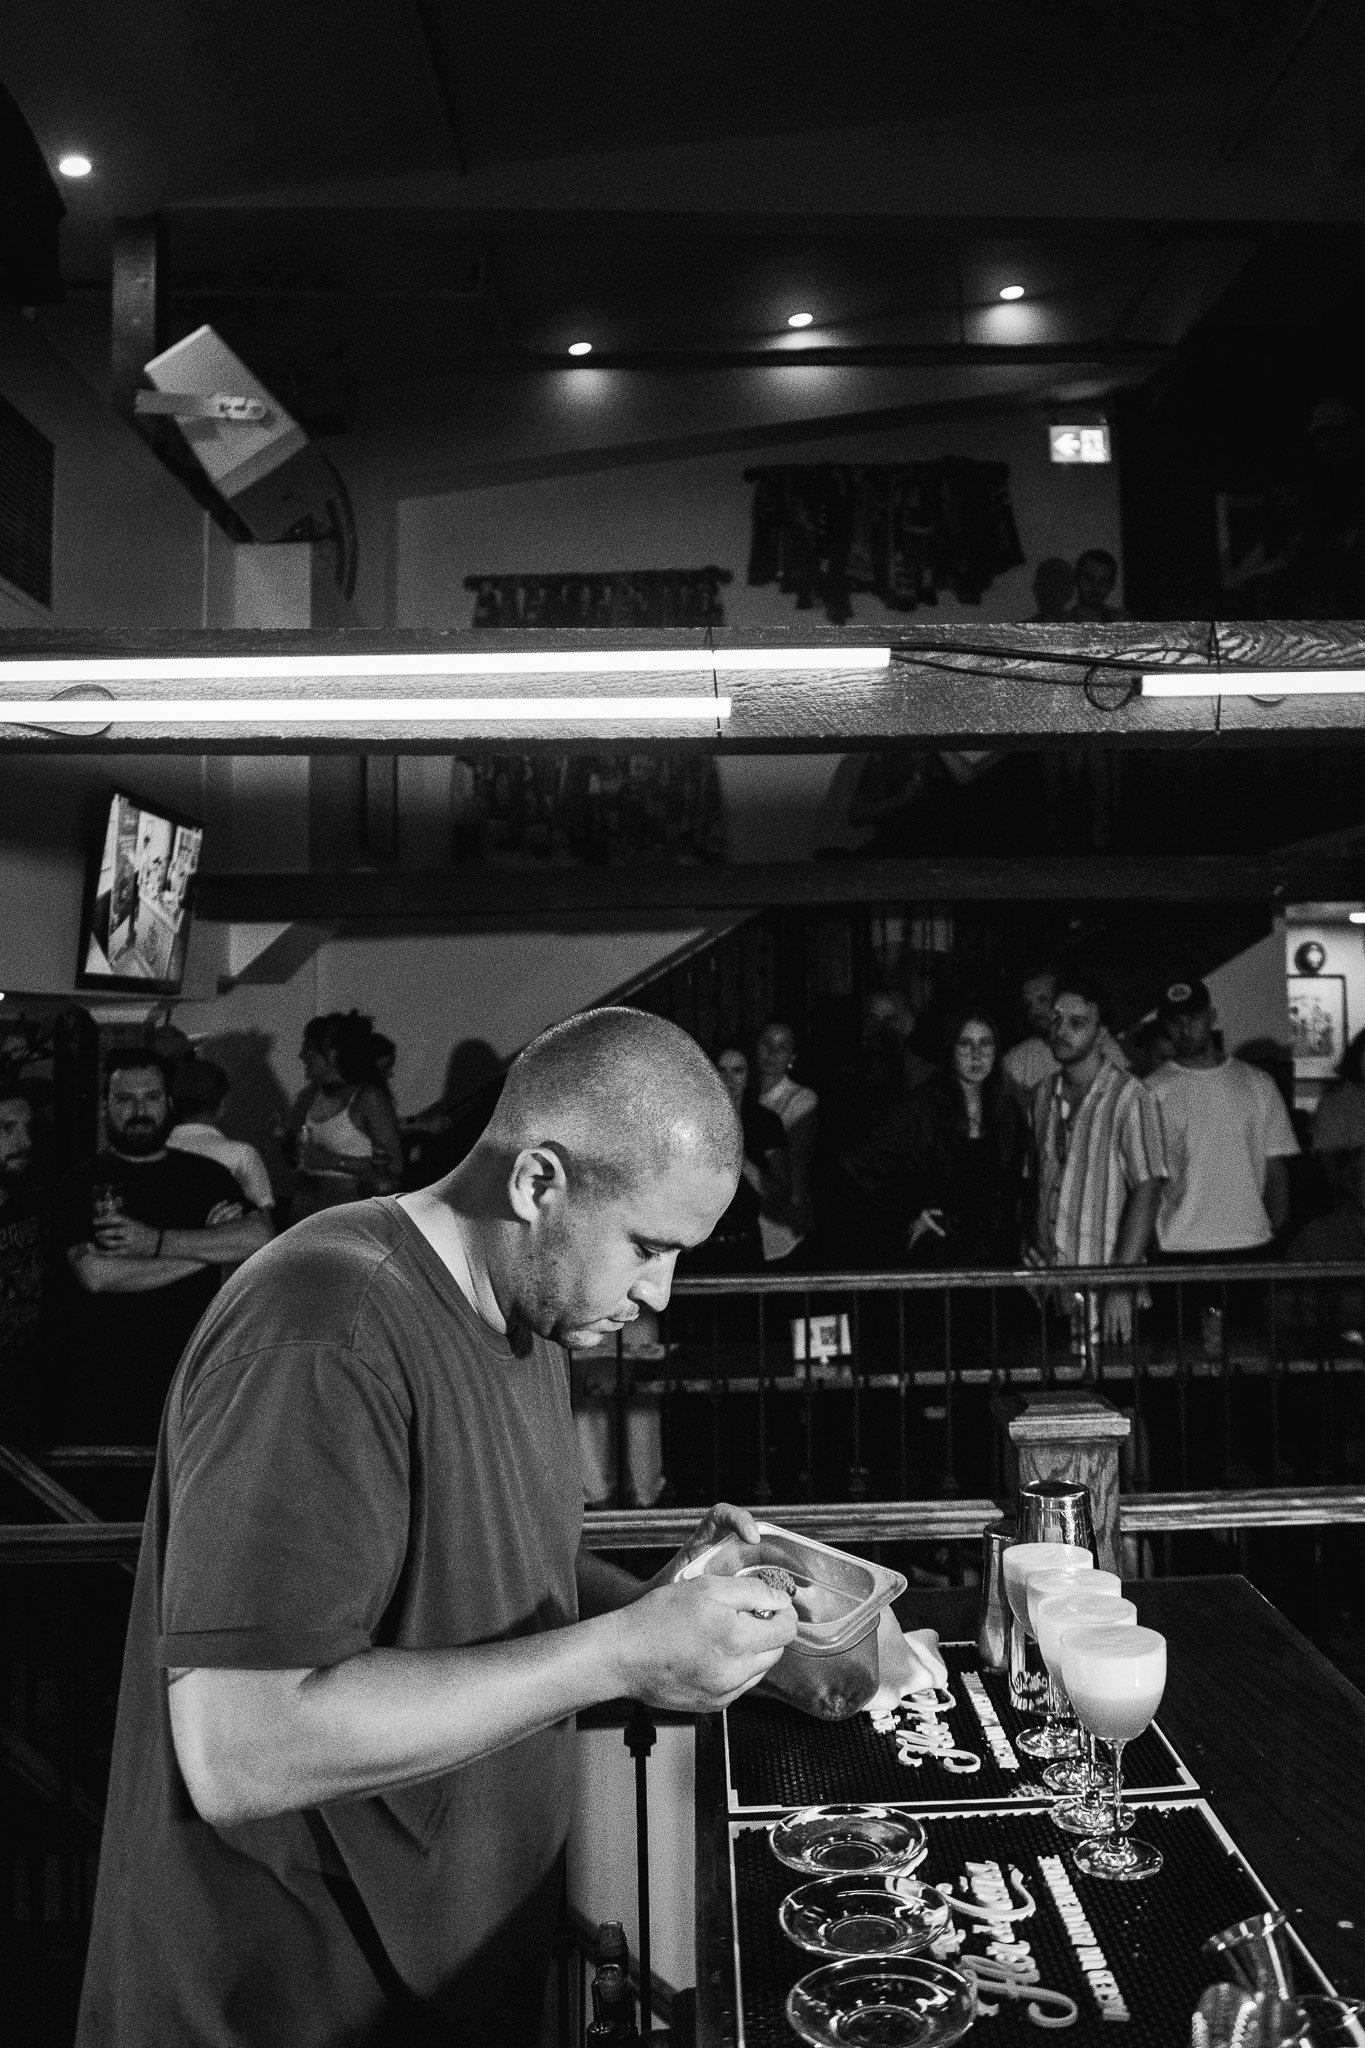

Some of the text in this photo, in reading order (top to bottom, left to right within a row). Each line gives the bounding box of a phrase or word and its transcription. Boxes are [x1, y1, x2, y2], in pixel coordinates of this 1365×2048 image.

[957, 1940, 1078, 2028] Flor
[1036, 1854, 1131, 2022] AGED IN ADVENTURE
